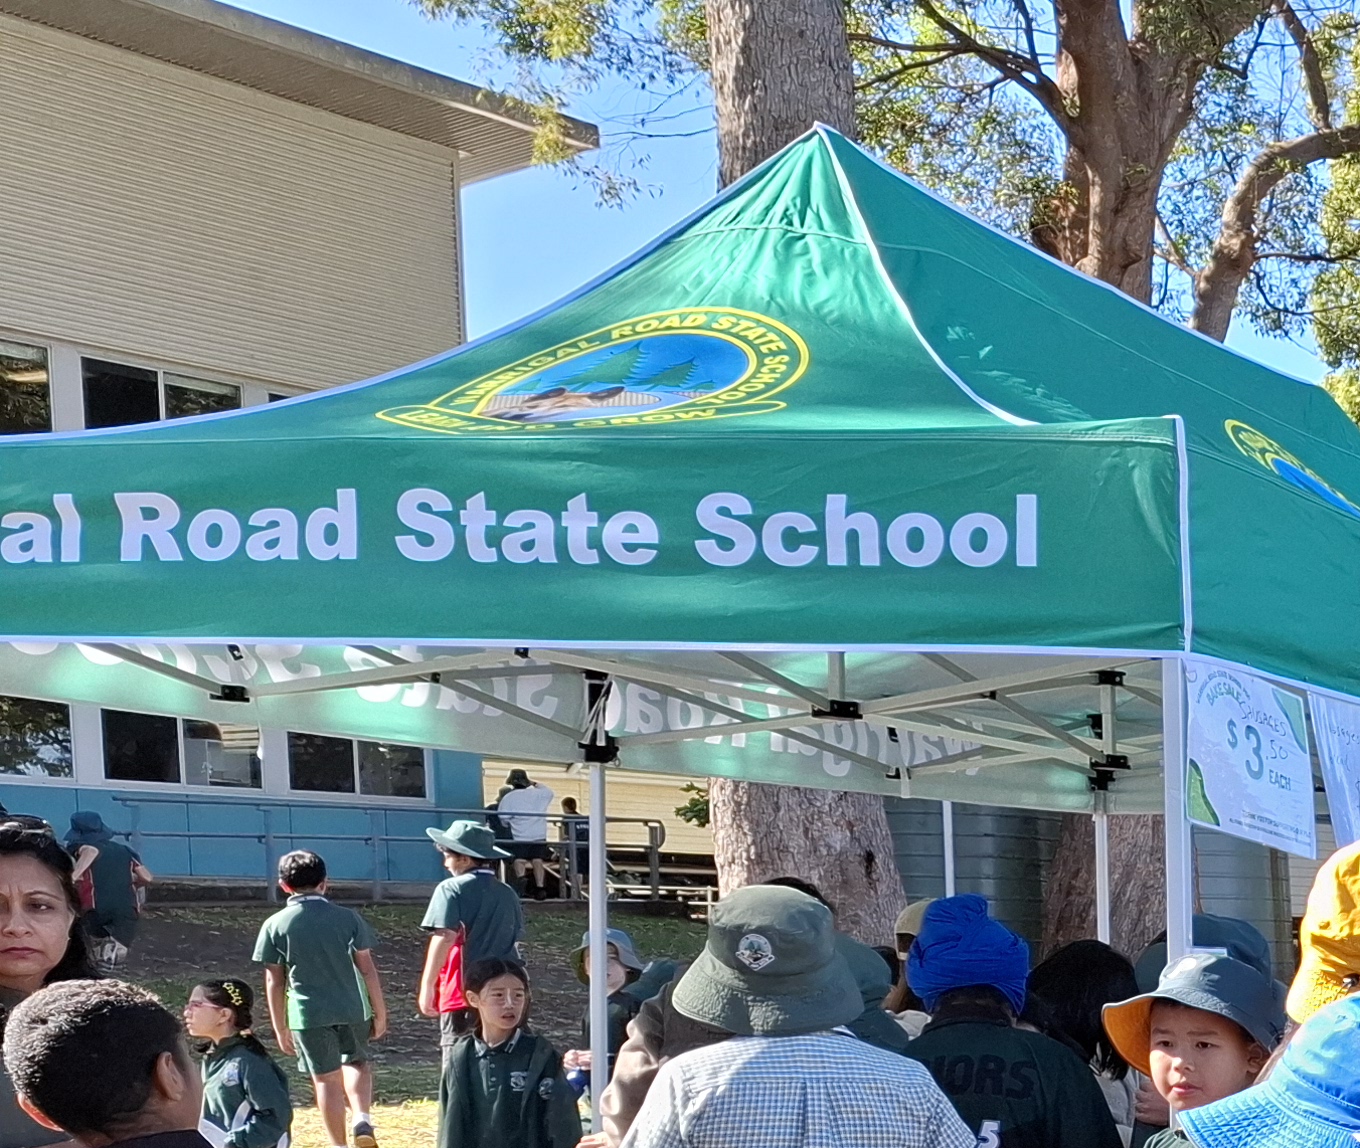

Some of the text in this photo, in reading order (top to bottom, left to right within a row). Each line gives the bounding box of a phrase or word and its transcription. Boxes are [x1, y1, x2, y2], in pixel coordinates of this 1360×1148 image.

[449, 314, 788, 406] WARRIGAL ROAD STATE SCHOOL
[573, 407, 717, 428] GROW
[113, 488, 359, 563] Road
[395, 487, 659, 565] State
[695, 491, 1038, 568] School
[1268, 768, 1291, 791] EACH
